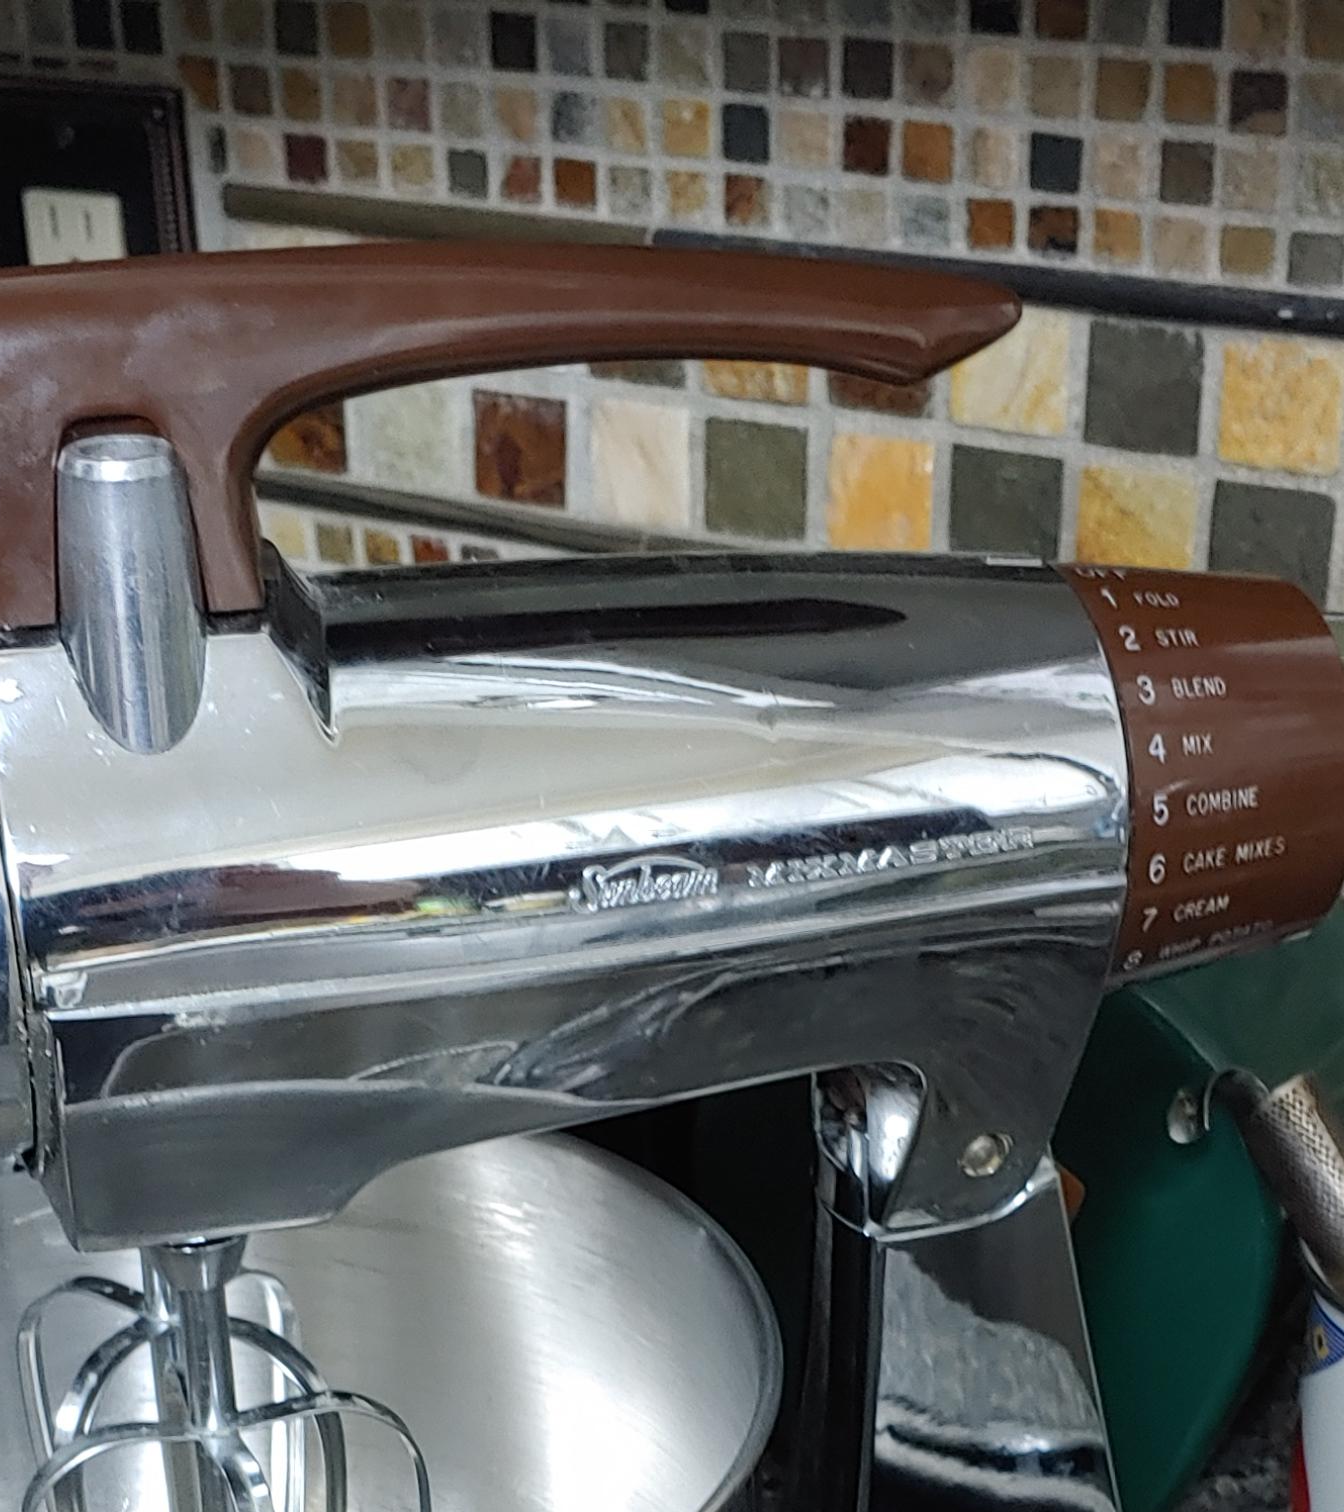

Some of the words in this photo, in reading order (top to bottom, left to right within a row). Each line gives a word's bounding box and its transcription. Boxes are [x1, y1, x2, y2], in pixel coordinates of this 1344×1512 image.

[1100, 587, 1118, 609] 1
[1133, 591, 1180, 608] FOLD
[1118, 625, 1141, 651] 2
[1154, 629, 1200, 648] STIR
[1136, 674, 1156, 705] 3
[1170, 675, 1227, 699] BLEND
[1148, 733, 1167, 764] 4
[1181, 733, 1214, 757] MIX
[1152, 793, 1170, 827] 5
[1185, 786, 1260, 817] COMBINE
[1148, 853, 1167, 885] 6
[1182, 847, 1227, 875] CAKE
[1234, 835, 1287, 865] MIXES
[1142, 906, 1159, 933] 7
[1173, 894, 1231, 924] CREAM
